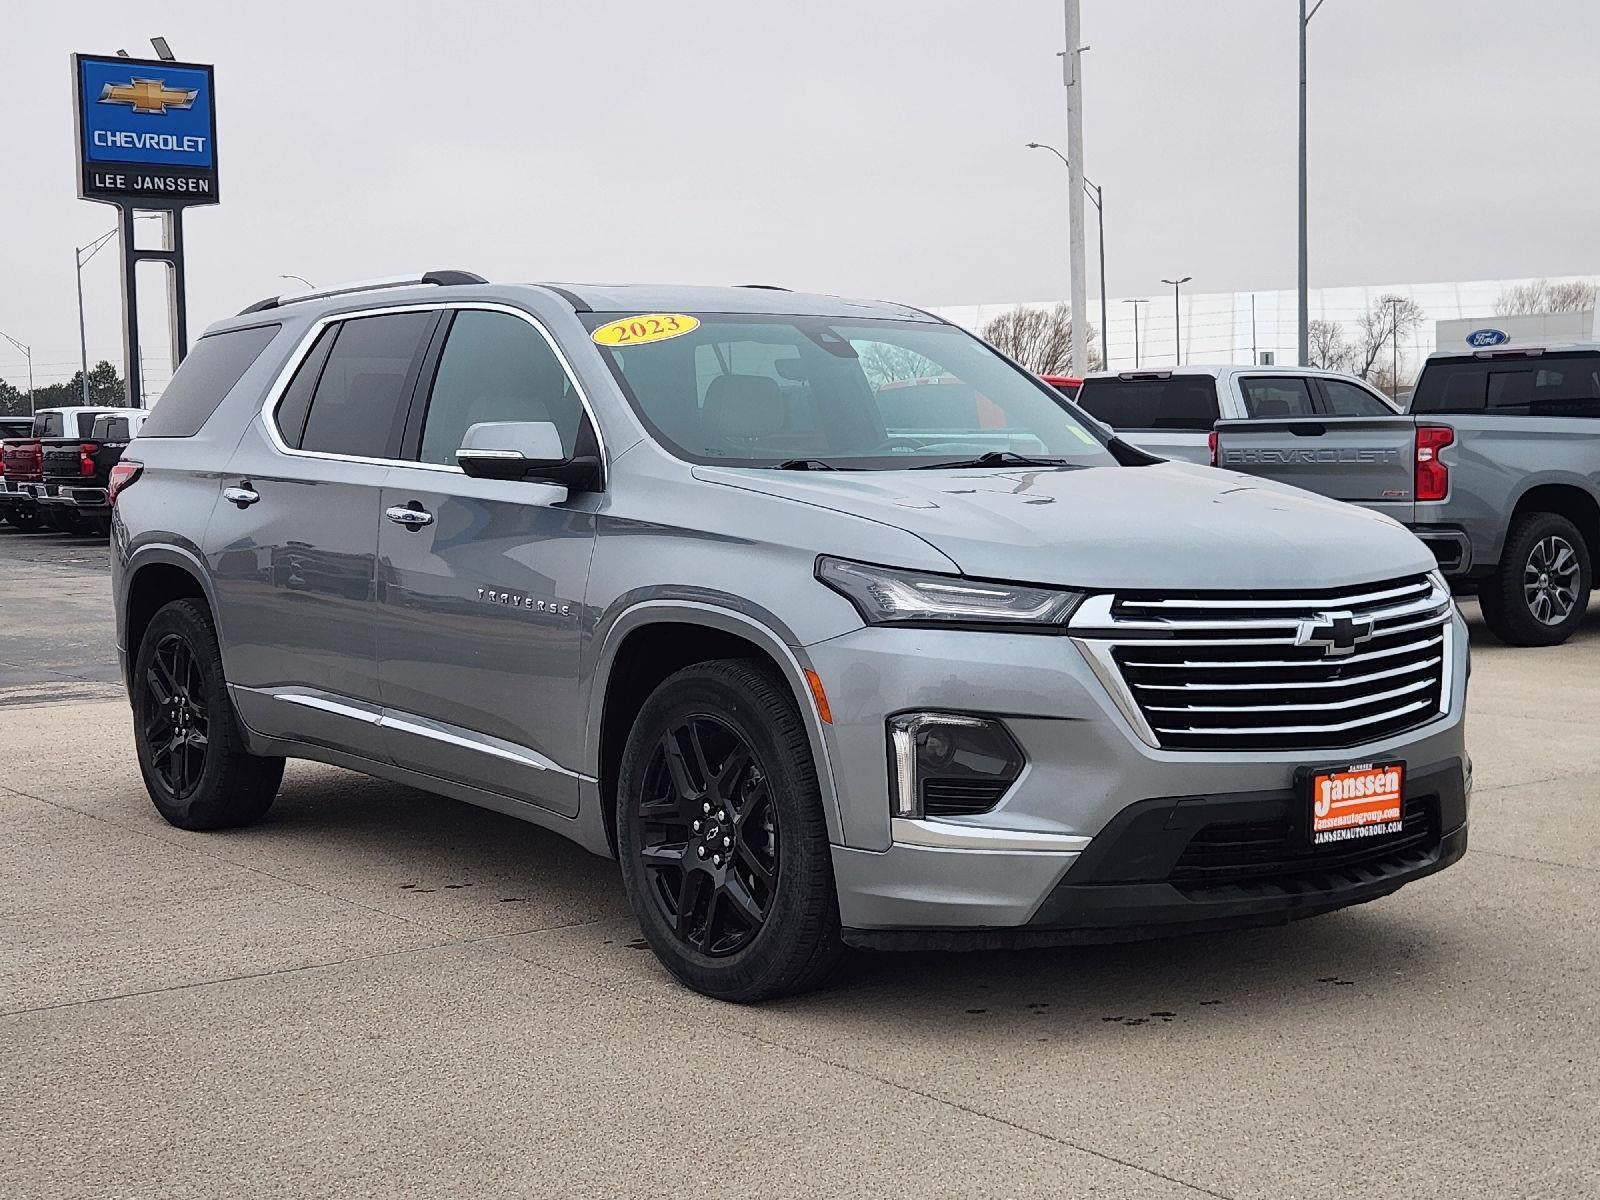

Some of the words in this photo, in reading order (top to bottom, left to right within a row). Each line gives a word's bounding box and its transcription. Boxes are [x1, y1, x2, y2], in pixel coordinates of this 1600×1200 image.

[93, 130, 206, 153] CHEVROLET
[95, 173, 126, 188] LEE
[133, 175, 209, 192] JANSSEN
[611, 316, 681, 343] 2023
[1225, 450, 1397, 463] CHEVROLET
[477, 588, 570, 617] TRAVERSE
[1314, 771, 1399, 818] Janssen
[1314, 820, 1403, 845] JANSSENAUTOGROUP.COM
